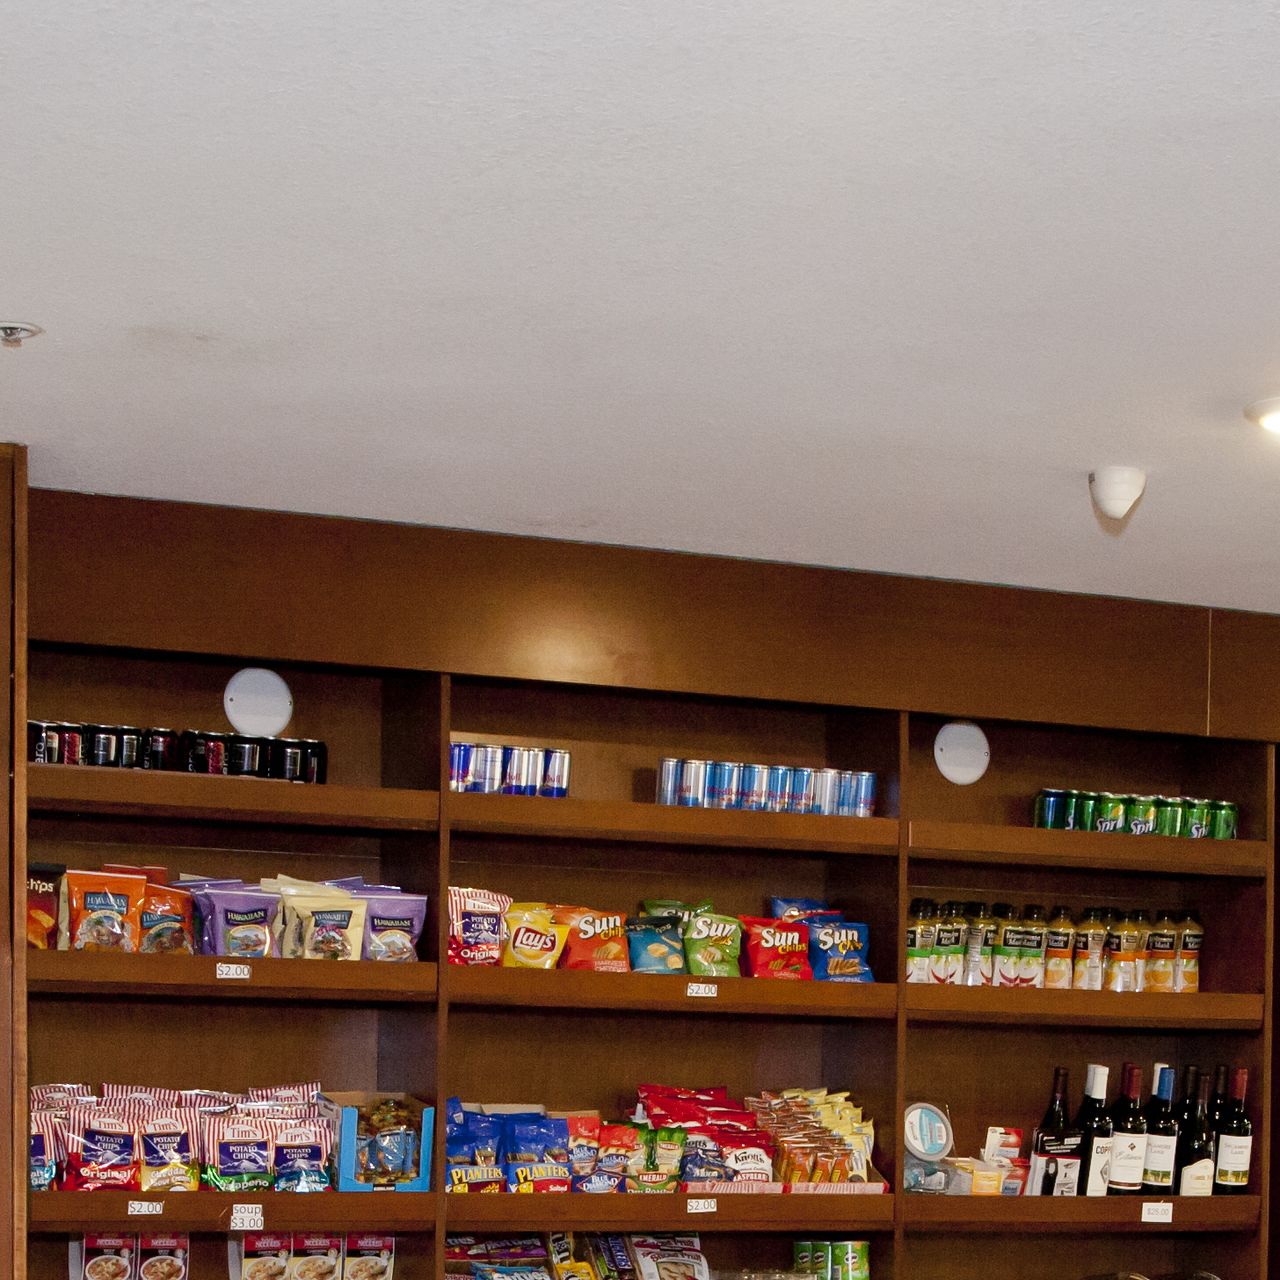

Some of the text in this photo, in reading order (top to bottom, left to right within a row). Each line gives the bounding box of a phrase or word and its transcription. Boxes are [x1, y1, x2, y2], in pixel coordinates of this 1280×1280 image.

[227, 911, 264, 921] HAWAIIAN
[374, 919, 410, 927] HAWAIIAN
[579, 915, 620, 940] Sun
[692, 917, 736, 939] Sun
[761, 929, 800, 947] Sun
[819, 927, 858, 949] Sun
[217, 965, 250, 977] $2.00
[688, 984, 716, 995] $2.00
[97, 1121, 123, 1130] Tim's
[152, 1122, 177, 1130] Tim's
[230, 1127, 258, 1139] Tim's
[285, 1132, 311, 1142] Tim's
[95, 1135, 123, 1144] POTATO
[153, 1136, 180, 1144] POTATO
[229, 1145, 258, 1153] POTATO
[80, 1168, 131, 1179] Original
[451, 1168, 502, 1184] PLANTERS
[516, 1166, 570, 1182] PLANTERS
[129, 1203, 162, 1214] $2.00
[234, 1205, 262, 1217] soup
[688, 1200, 716, 1211] $2.00
[231, 1217, 263, 1229] $3.00
[650, 1252, 701, 1262] Sliced Fruit
